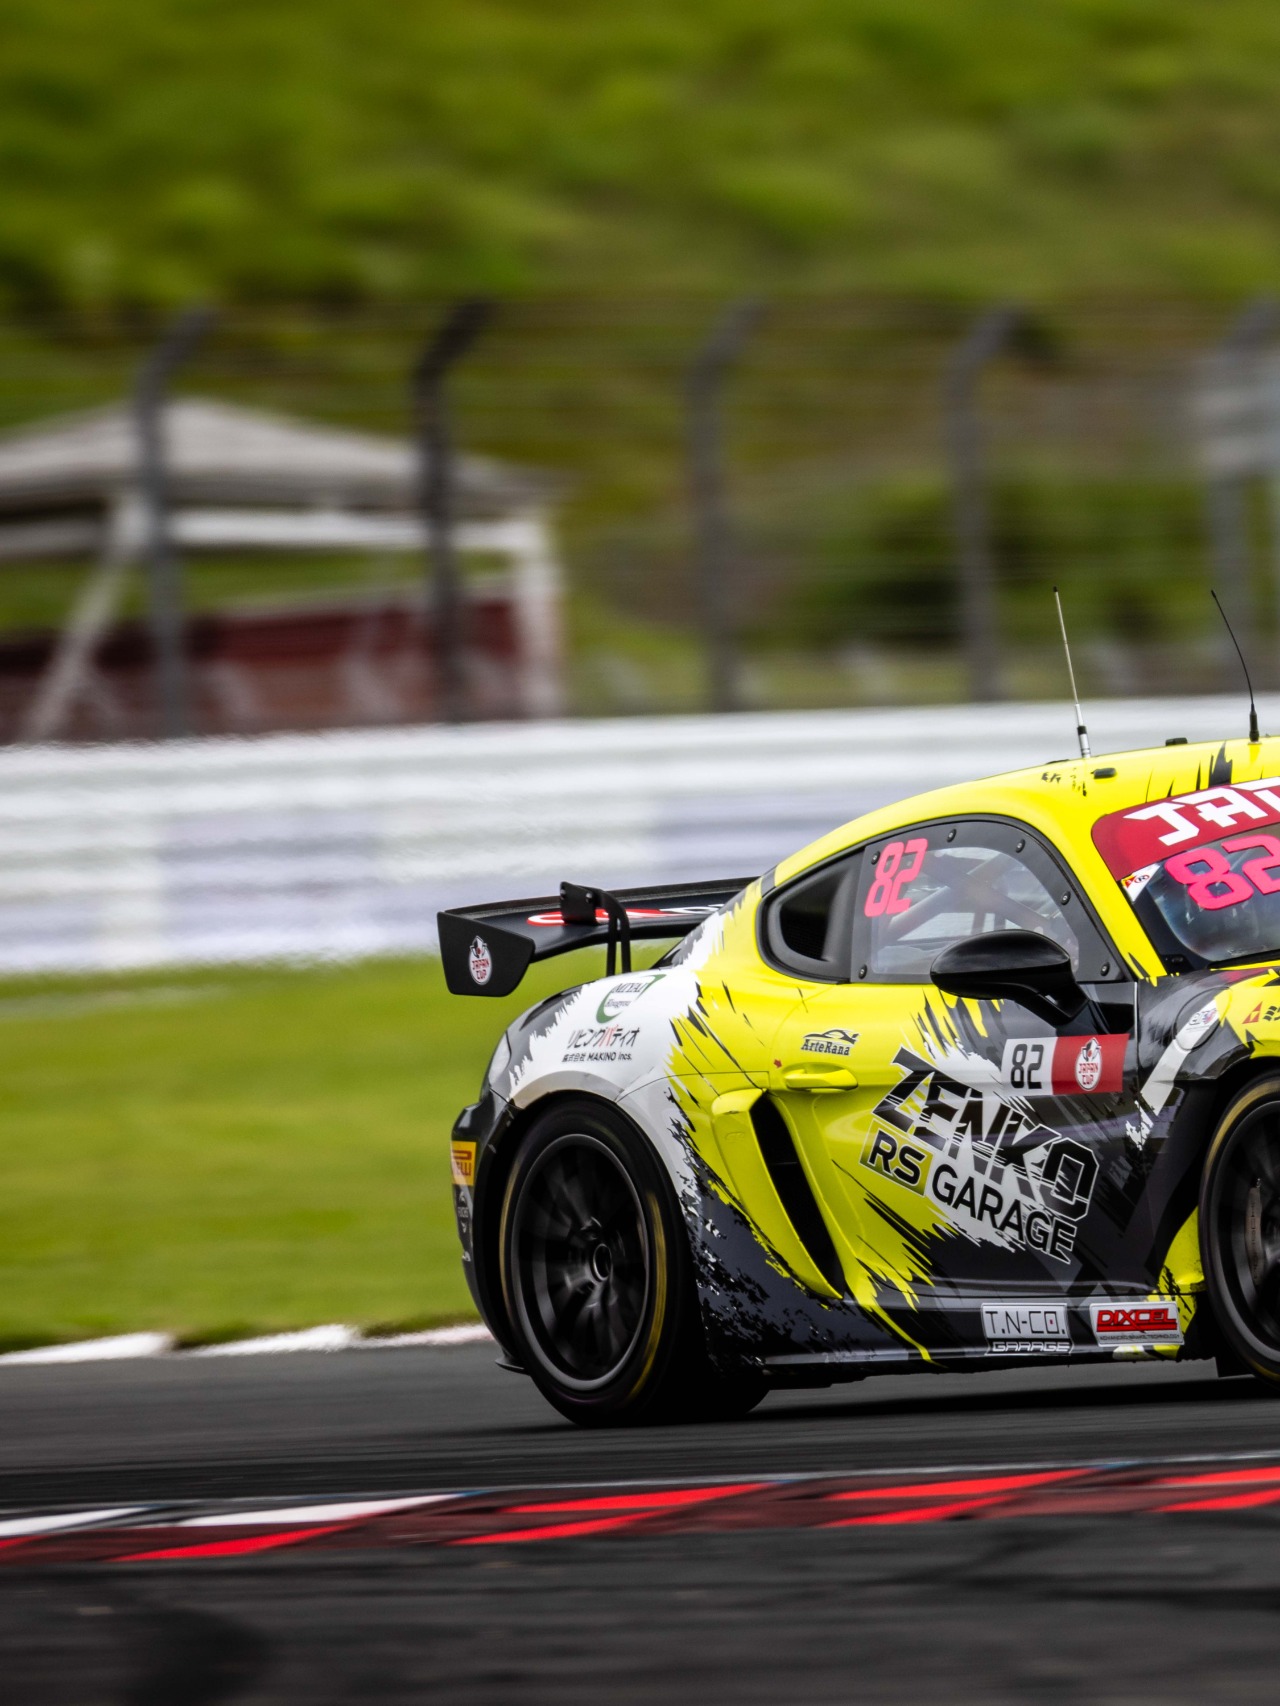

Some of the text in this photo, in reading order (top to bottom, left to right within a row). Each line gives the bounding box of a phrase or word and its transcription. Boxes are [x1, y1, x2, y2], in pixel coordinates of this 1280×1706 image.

[864, 838, 928, 917] 82
[587, 1051, 617, 1061] MAKINO
[1010, 1043, 1044, 1090] 82
[871, 1044, 1100, 1221] ZENKO
[867, 1129, 1078, 1265] RS GARAGE
[1097, 1308, 1178, 1333] DIXCEL
[993, 1341, 1072, 1353] GARAGE
